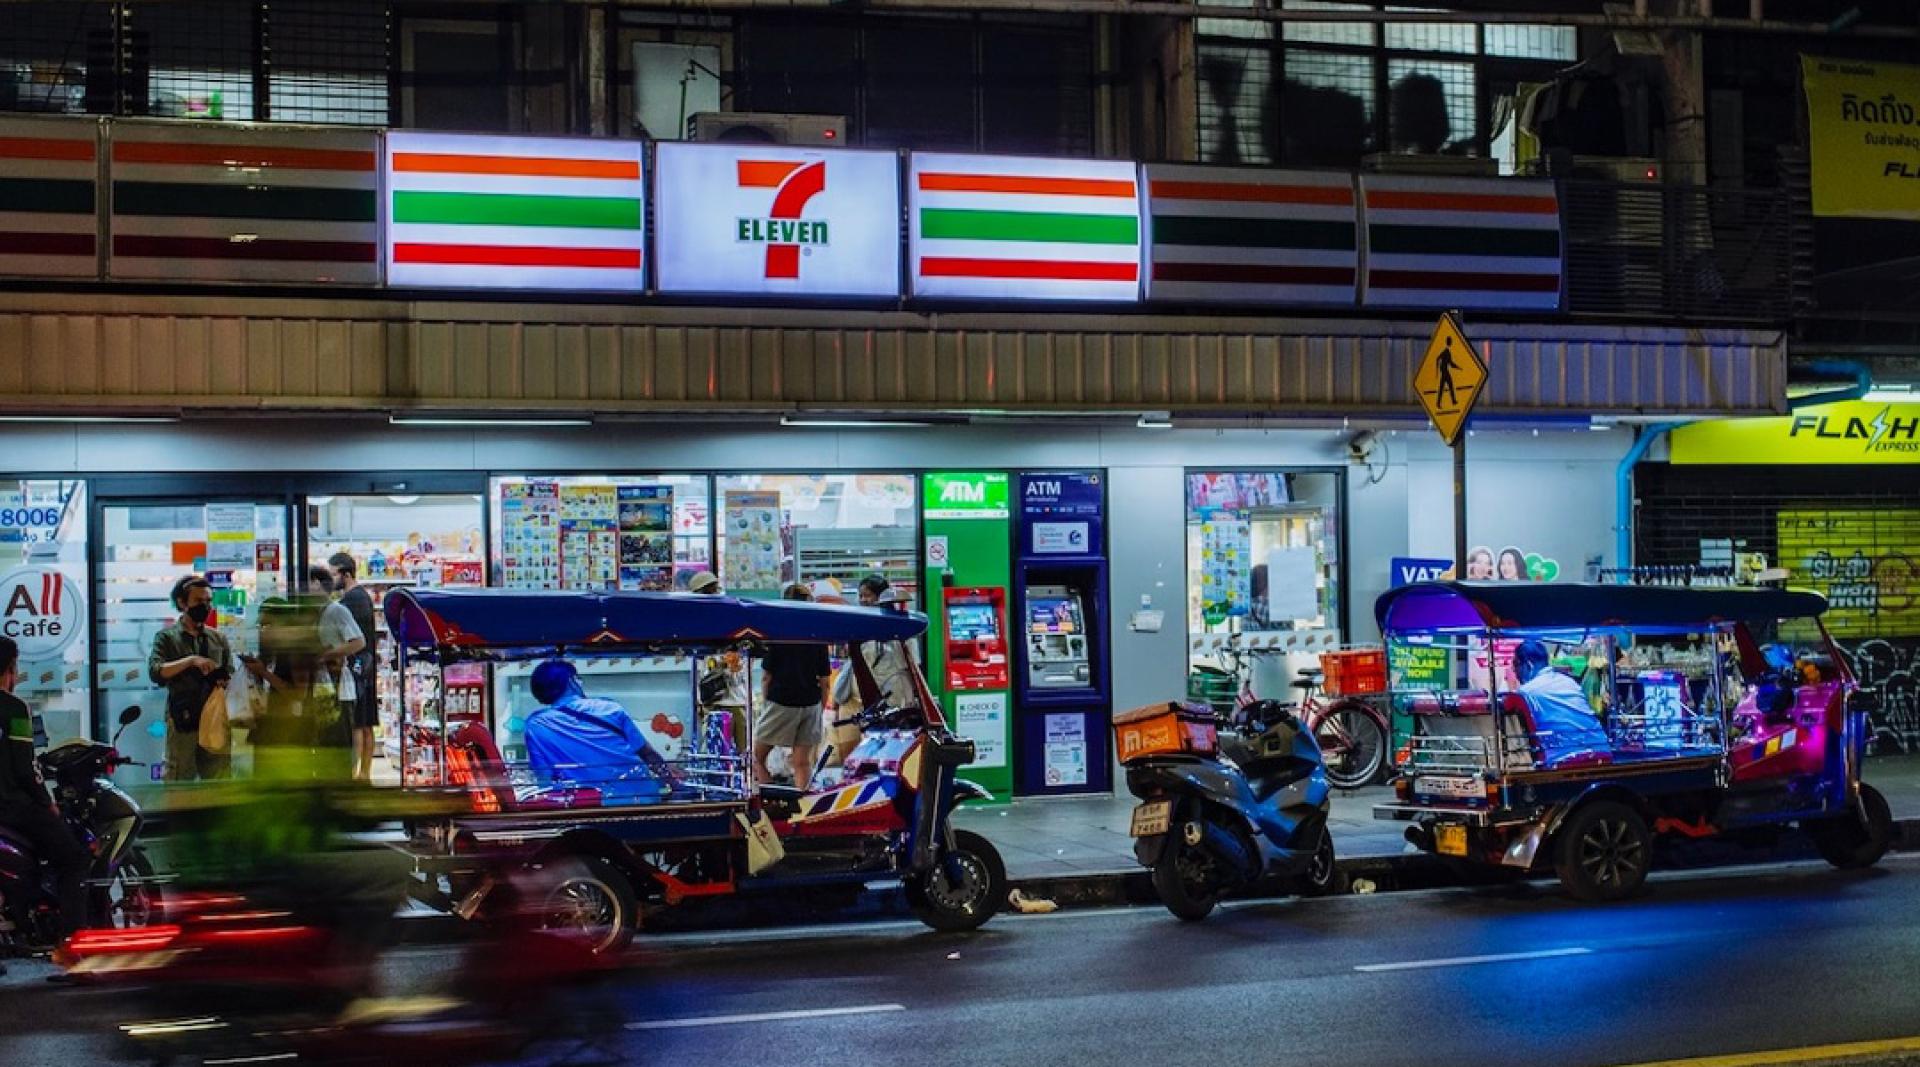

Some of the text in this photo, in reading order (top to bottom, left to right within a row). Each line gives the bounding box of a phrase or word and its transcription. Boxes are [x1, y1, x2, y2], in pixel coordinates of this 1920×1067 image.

[737, 160, 825, 278] 7
[1876, 442, 1919, 452] EXPRESS
[940, 481, 985, 502] ATM
[1025, 481, 1061, 496] ATM
[1, 508, 58, 527] 8006
[1402, 566, 1443, 584] VAT
[5, 572, 63, 616] All
[4, 617, 62, 637] Café
[1411, 647, 1446, 657] REFUND
[1394, 657, 1445, 669] AVAILABLE
